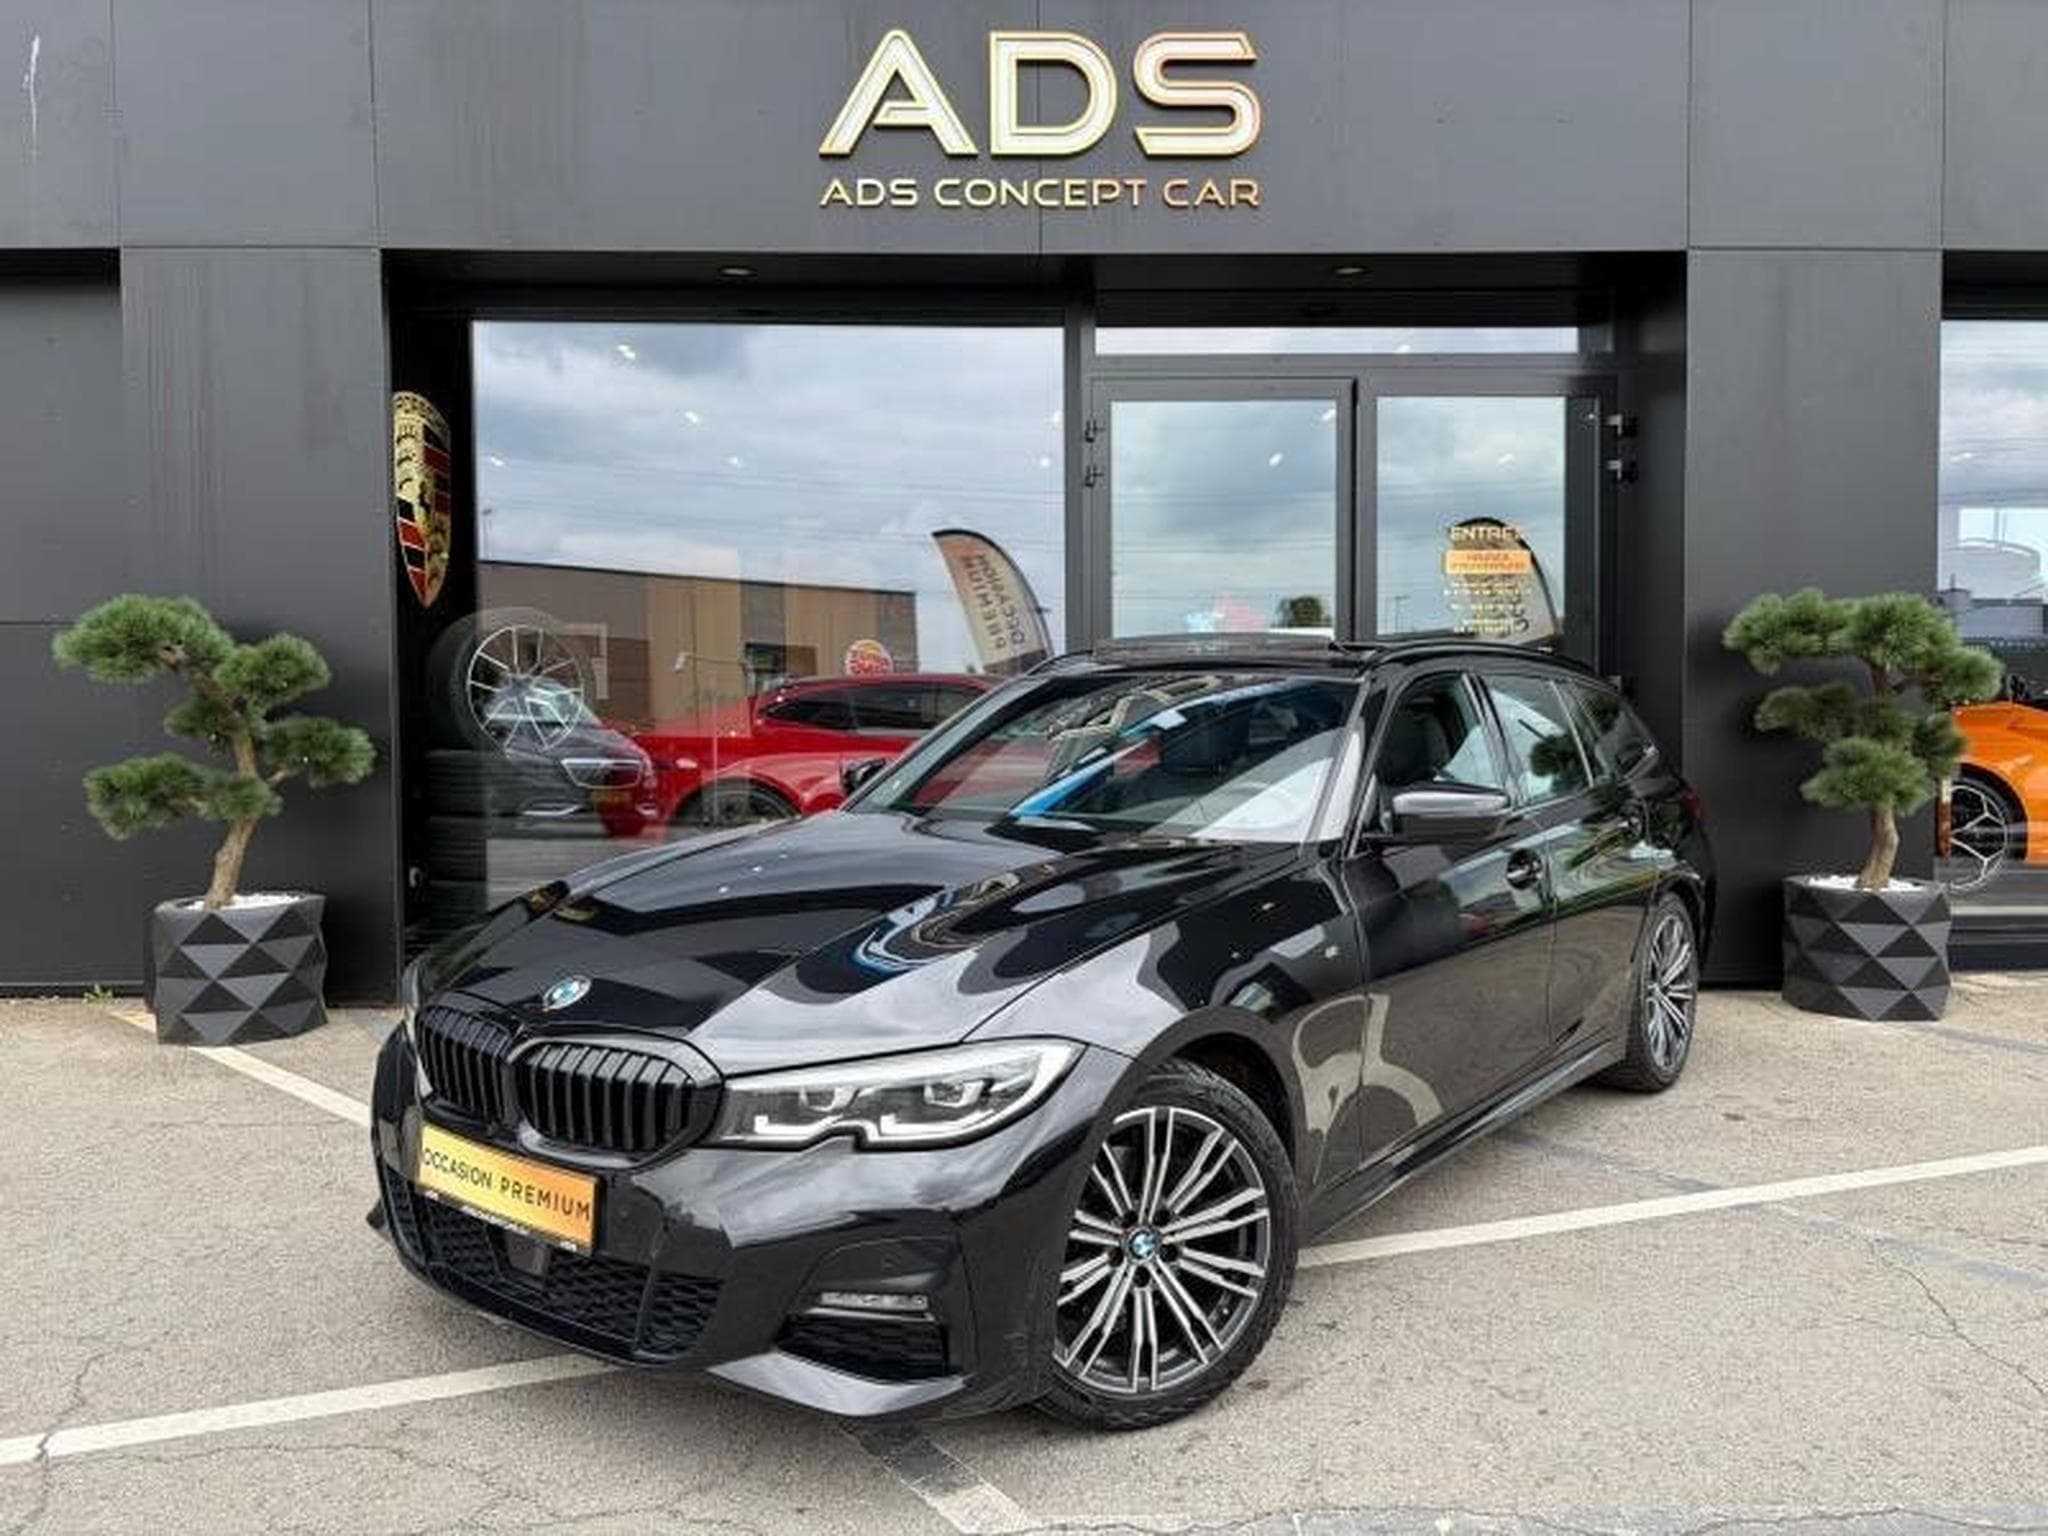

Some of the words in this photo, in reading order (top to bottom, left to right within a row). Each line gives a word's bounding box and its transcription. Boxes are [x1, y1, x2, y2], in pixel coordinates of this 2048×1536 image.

[819, 29, 1261, 157] ADS
[820, 179, 917, 207] ADS
[935, 179, 1148, 208] CONCEPT
[1164, 179, 1260, 208] CAR
[423, 1147, 495, 1190] OCCASION
[500, 1175, 592, 1222] PREMIUM
